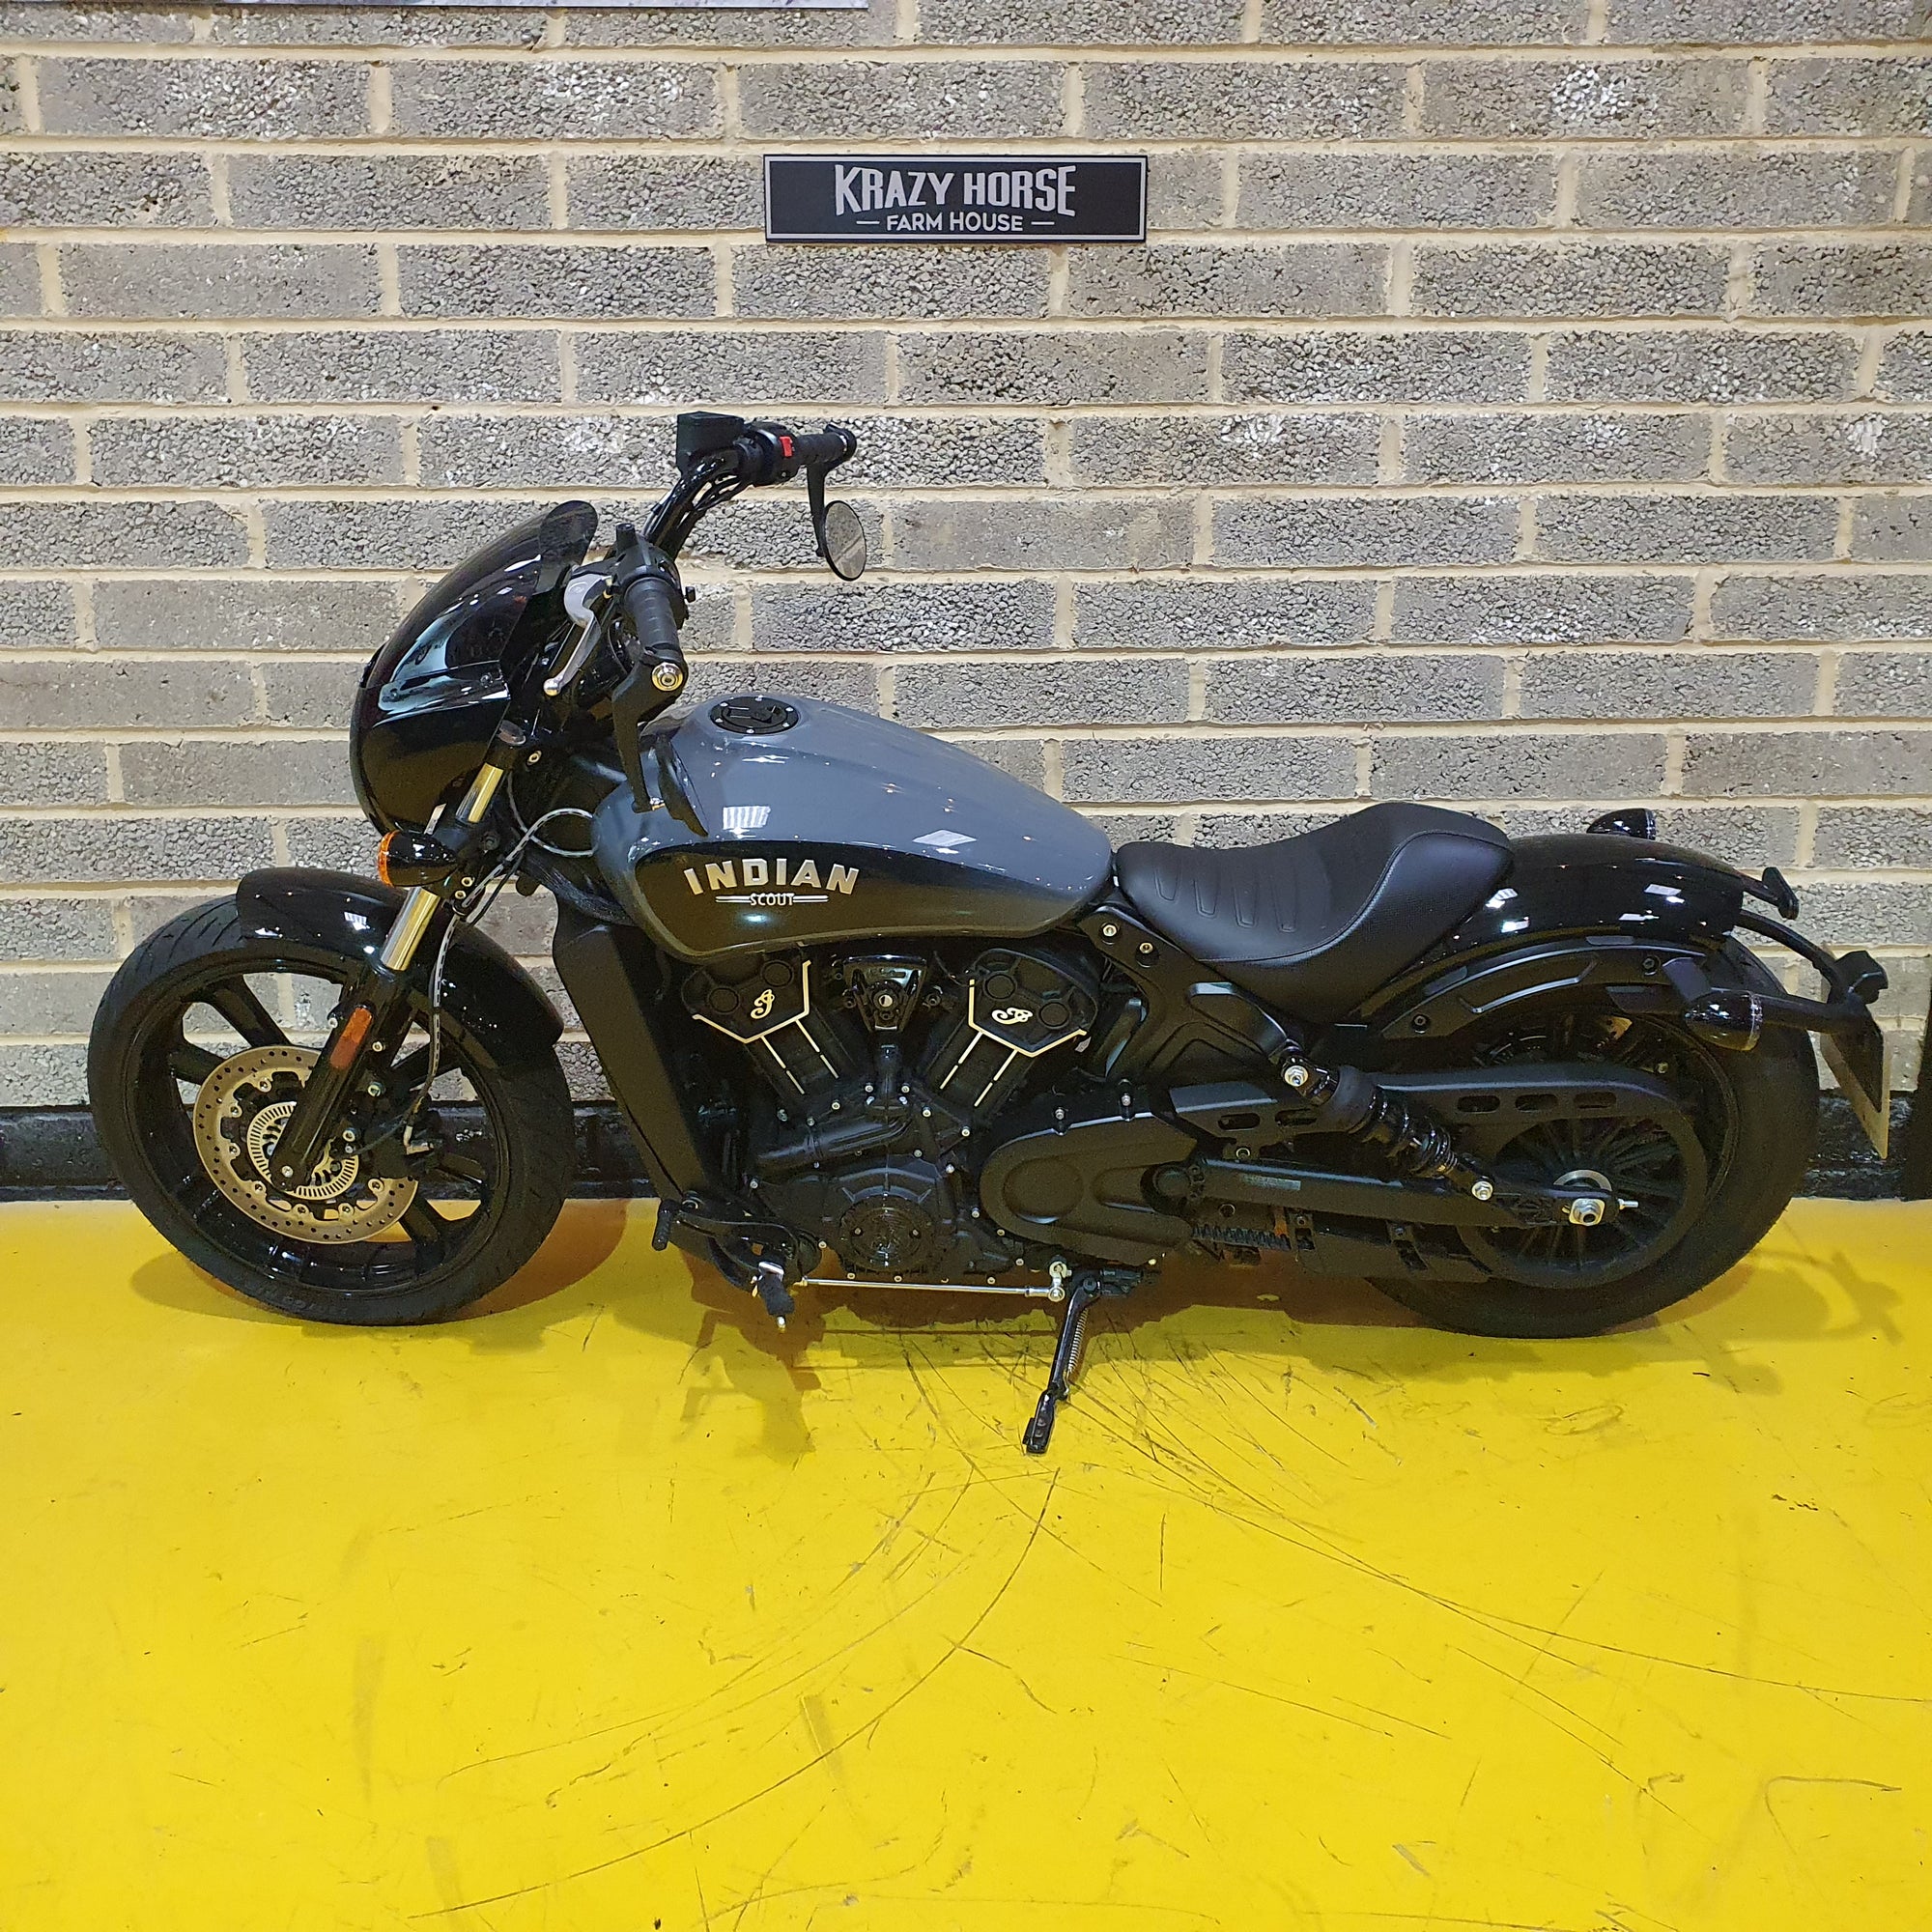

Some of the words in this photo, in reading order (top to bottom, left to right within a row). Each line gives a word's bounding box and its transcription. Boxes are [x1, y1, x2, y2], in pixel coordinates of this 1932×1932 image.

[835, 164, 954, 215] KRAZY
[964, 164, 1077, 216] HORSE
[886, 213, 943, 231] FARM
[950, 211, 1024, 232] HOUSE
[683, 858, 860, 895] INDIAN
[750, 893, 795, 906] SCOUT
